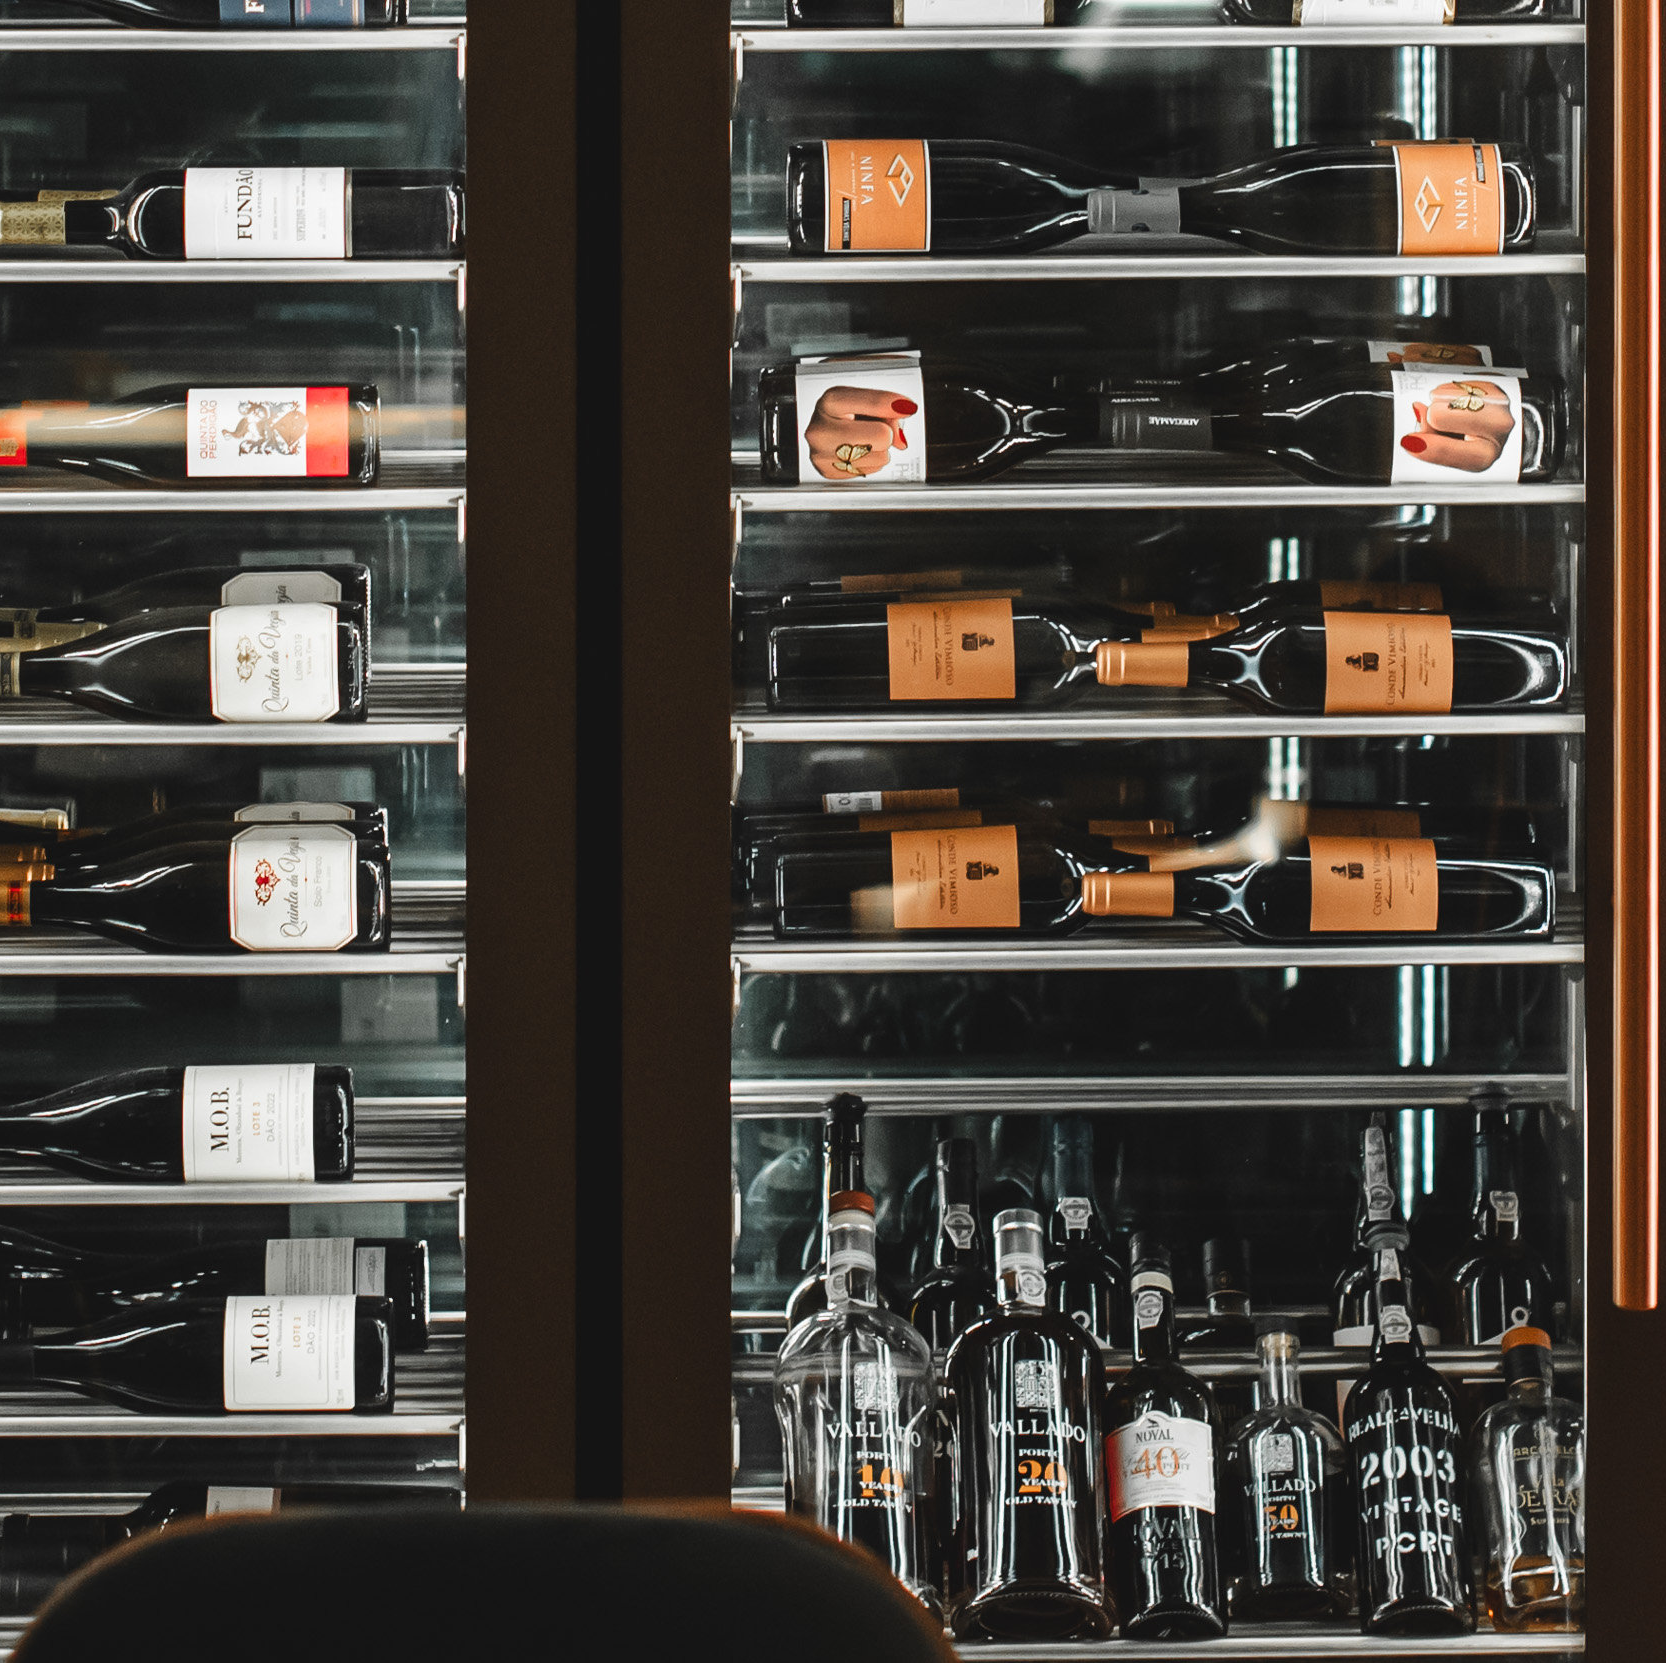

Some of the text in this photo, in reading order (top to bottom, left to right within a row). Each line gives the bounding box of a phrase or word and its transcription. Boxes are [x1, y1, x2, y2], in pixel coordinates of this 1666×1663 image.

[859, 156, 874, 205] NINFA
[1455, 176, 1468, 230] NINFA
[234, 170, 255, 240] FUNDÃO
[200, 399, 208, 459] QUINTA DO
[207, 400, 218, 459] PERDIGÃO
[293, 633, 303, 681] Lote 2019
[945, 639, 954, 686] VIMIOSO
[261, 651, 289, 712] Quinta da
[1386, 669, 1396, 705] CONDE
[314, 855, 323, 907] Solo Franco
[949, 868, 958, 915] VIMIOSO
[1372, 877, 1382, 915] CONDE
[279, 874, 308, 938] Quinta da
[209, 1087, 230, 1152] M.O.B.
[252, 1111, 261, 1136] LOTE
[265, 1093, 275, 1142] DÃO 2022
[250, 1305, 271, 1365] M.O.B.
[292, 1325, 301, 1348] LOTE
[305, 1332, 316, 1354] DÃO
[989, 1419, 1085, 1443] VALLADO
[1135, 1429, 1174, 1444] NOVAL
[856, 1464, 904, 1499] 10
[1017, 1460, 1068, 1495] 20
[1131, 1446, 1180, 1480] 40
[1360, 1444, 1456, 1490] 2003
[1263, 1504, 1299, 1532] 50
[1361, 1495, 1463, 1524] VINTAGE
[1375, 1530, 1453, 1560] PORT
